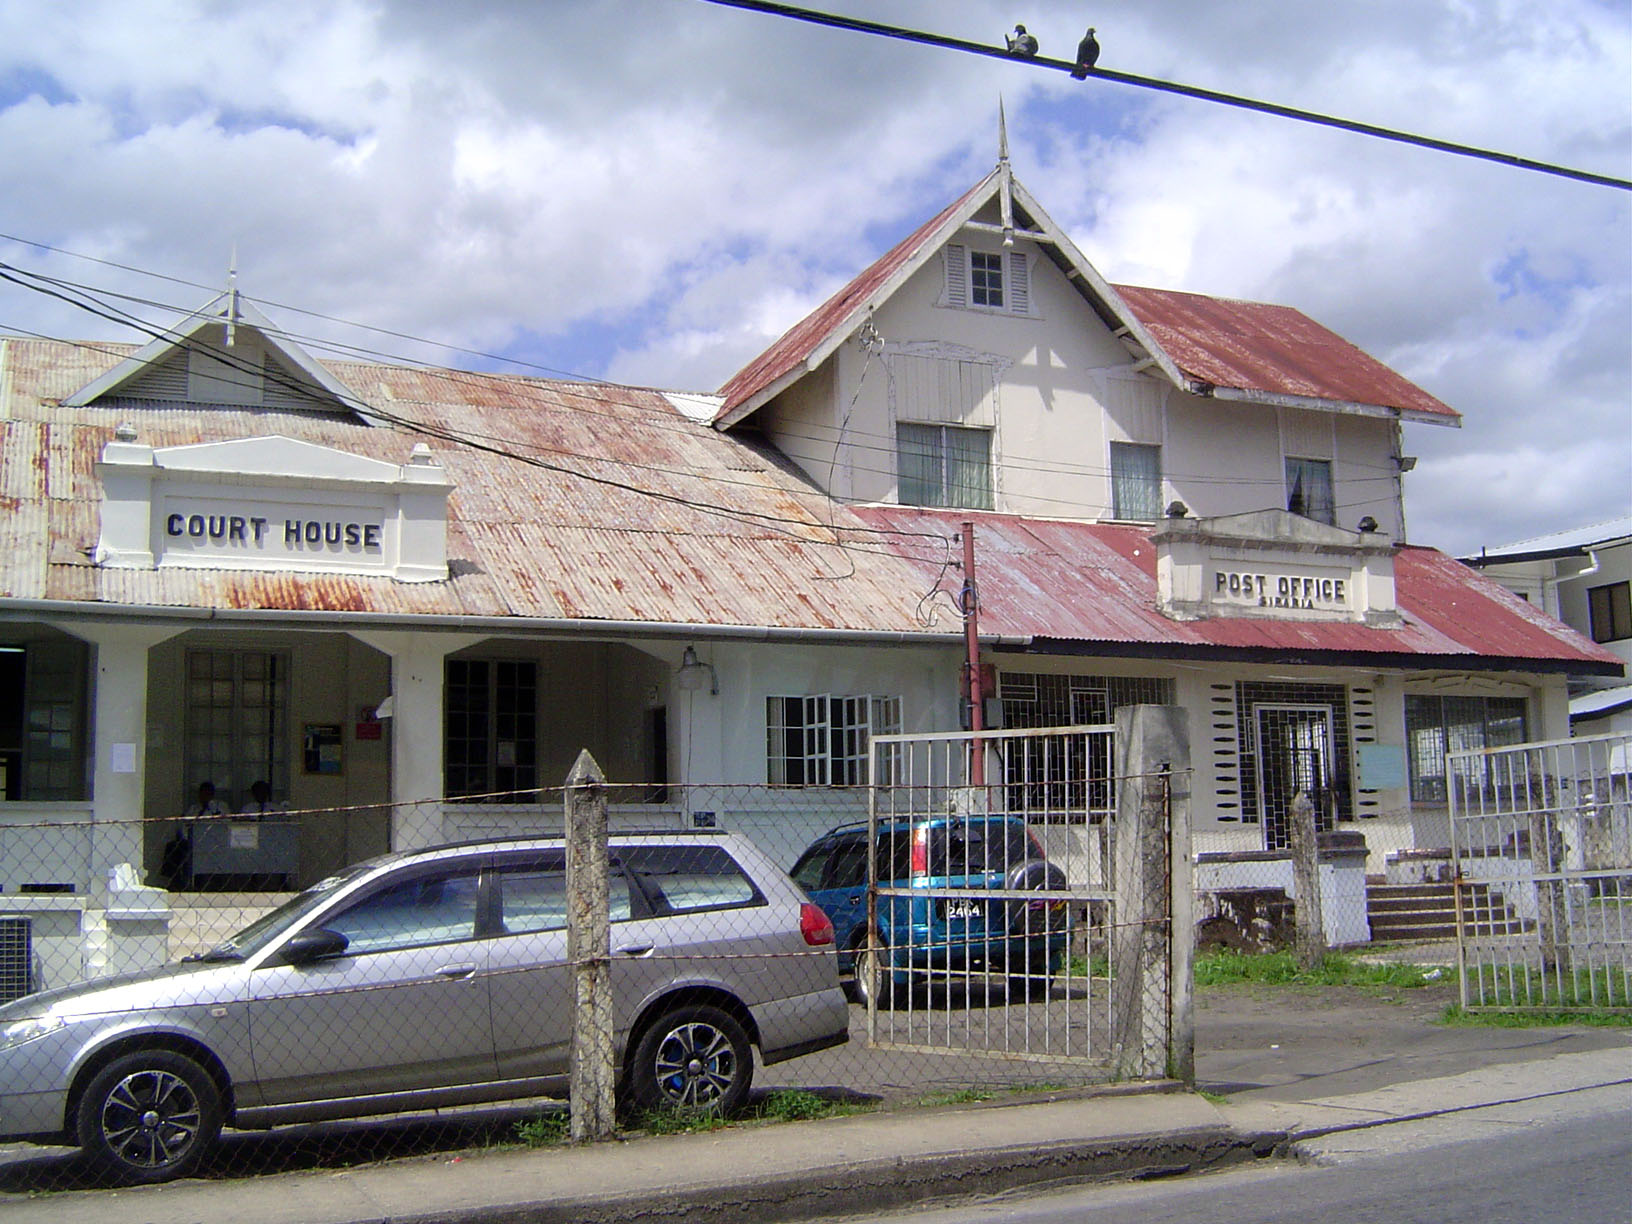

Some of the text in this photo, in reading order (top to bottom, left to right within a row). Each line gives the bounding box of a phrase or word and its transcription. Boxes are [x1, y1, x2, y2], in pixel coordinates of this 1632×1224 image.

[167, 513, 380, 547] COURT HOUSE
[1216, 572, 1344, 599] POST OFFICE
